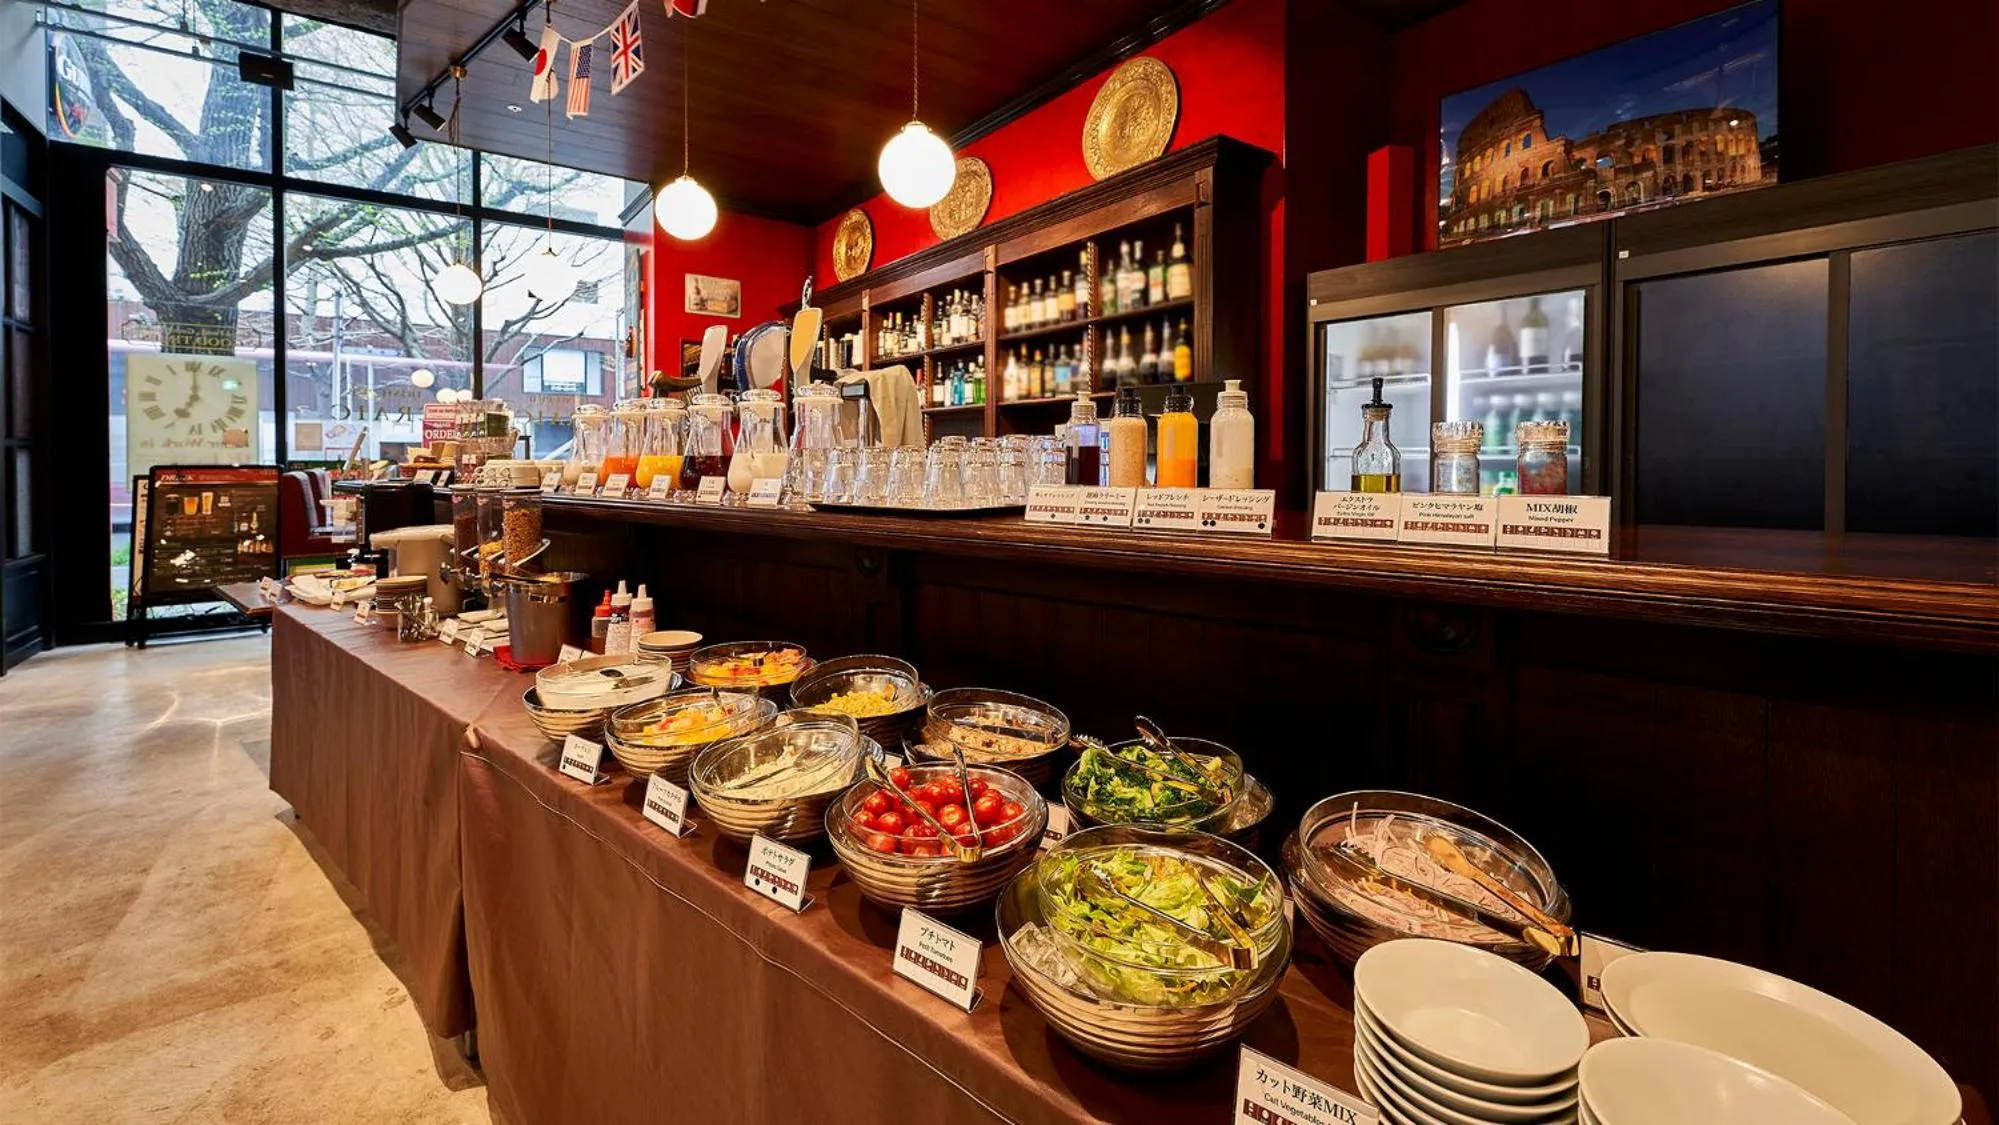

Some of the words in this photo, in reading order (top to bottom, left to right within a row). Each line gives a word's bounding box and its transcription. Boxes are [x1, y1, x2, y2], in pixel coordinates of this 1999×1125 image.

[424, 428, 456, 440] ORDE
[1146, 493, 1189, 502] レッドフレンチ
[1341, 495, 1374, 504] エクストラ
[1332, 503, 1380, 512] バージンオイル
[1412, 502, 1484, 511] ピンクヒマラヤン塩
[1526, 503, 1578, 514] MIX胡椒
[920, 926, 956, 951] プチトマト
[1256, 1067, 1357, 1125] カット野菜MIX
